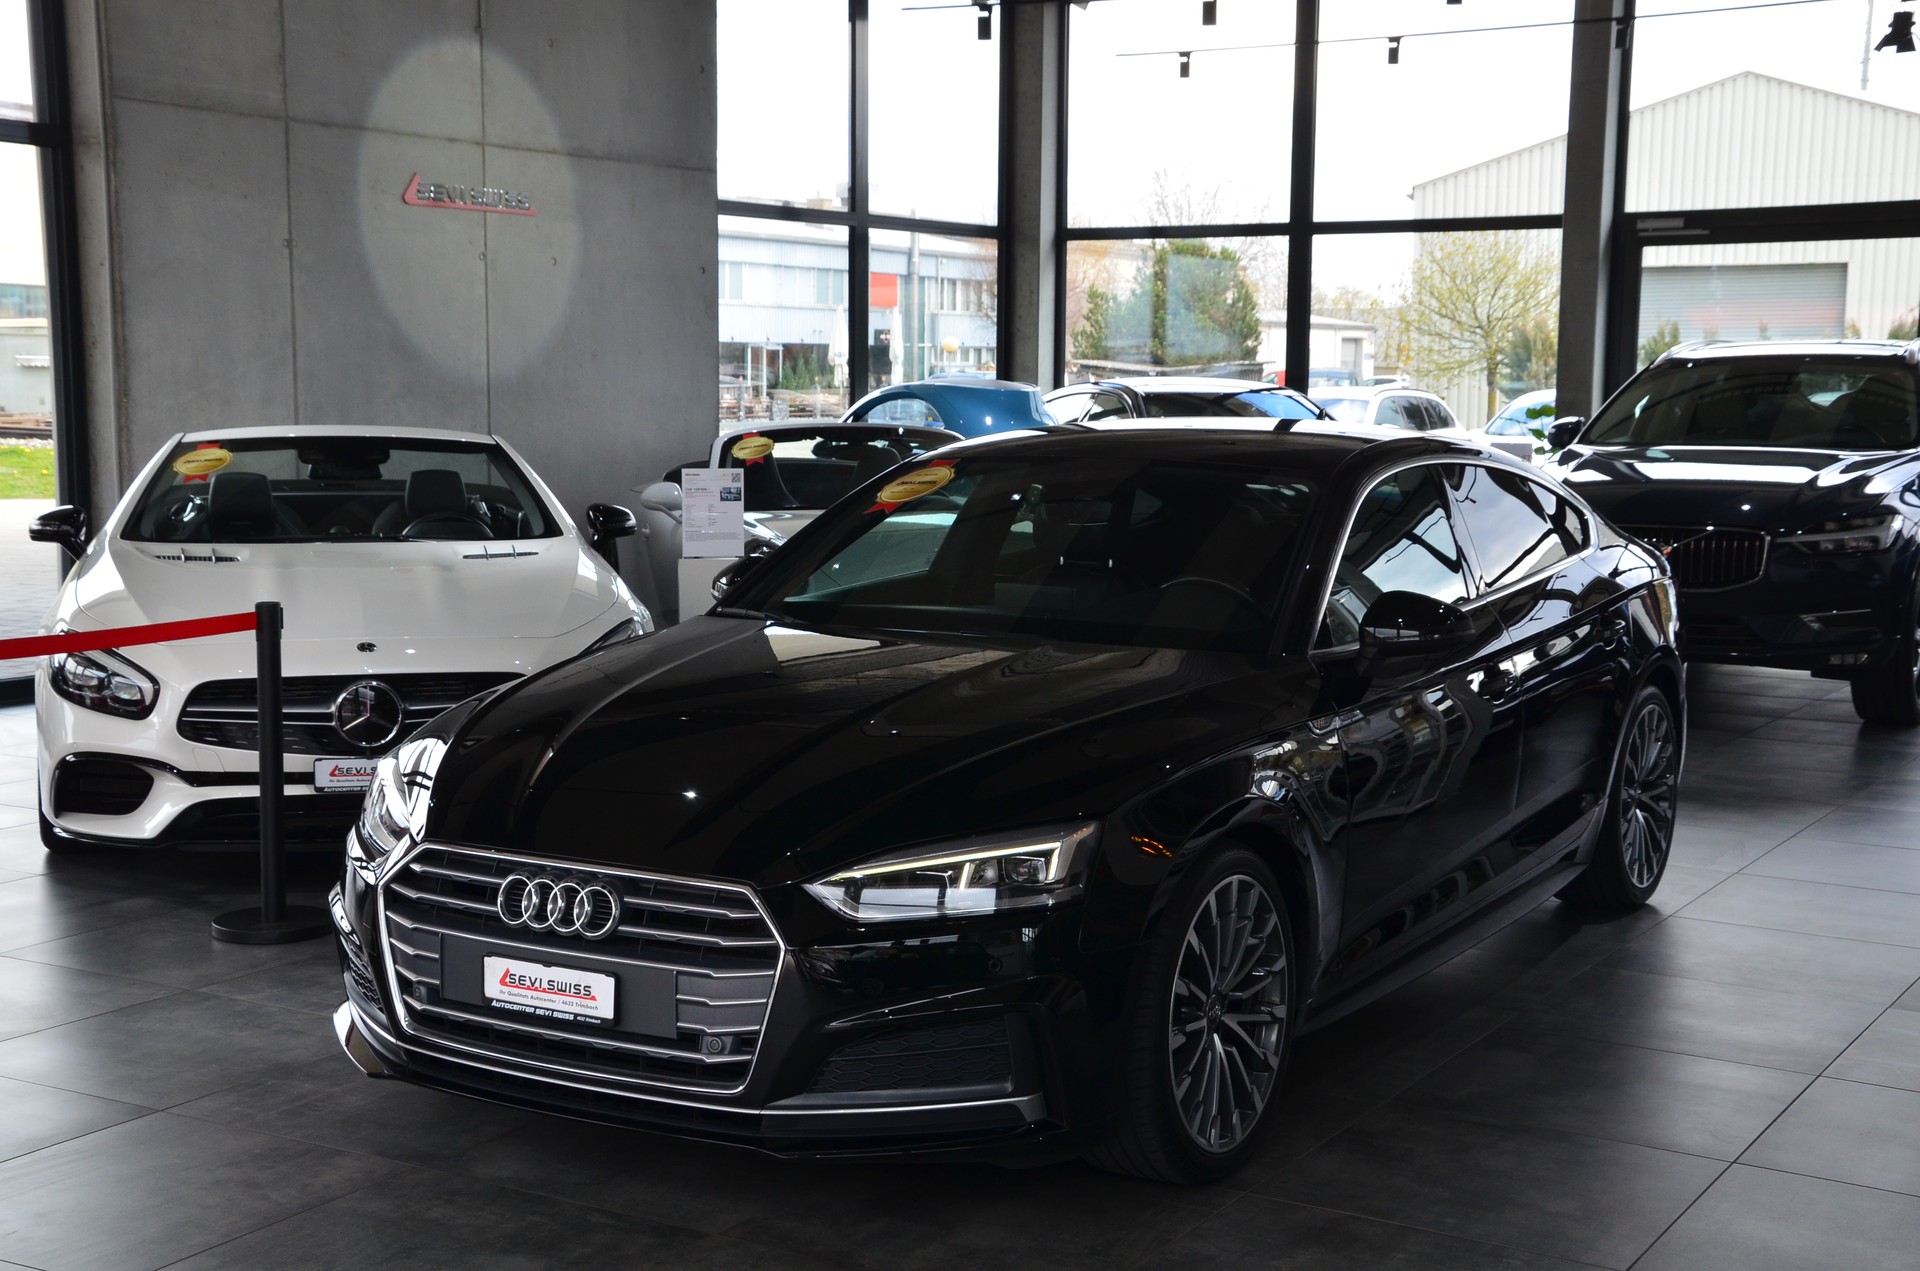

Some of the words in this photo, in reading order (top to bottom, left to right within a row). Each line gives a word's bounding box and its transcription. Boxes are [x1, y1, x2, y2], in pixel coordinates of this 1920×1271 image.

[416, 182, 467, 205] SEVI
[470, 187, 530, 210] SWISS
[337, 766, 367, 775] SEVI
[508, 973, 542, 989] SEVI
[547, 980, 592, 997] SWISS
[529, 995, 557, 1004] Autocenter
[575, 1002, 599, 1011] Trimbach
[535, 1009, 552, 1017] SEVI
[553, 1011, 574, 1020] SWISS
